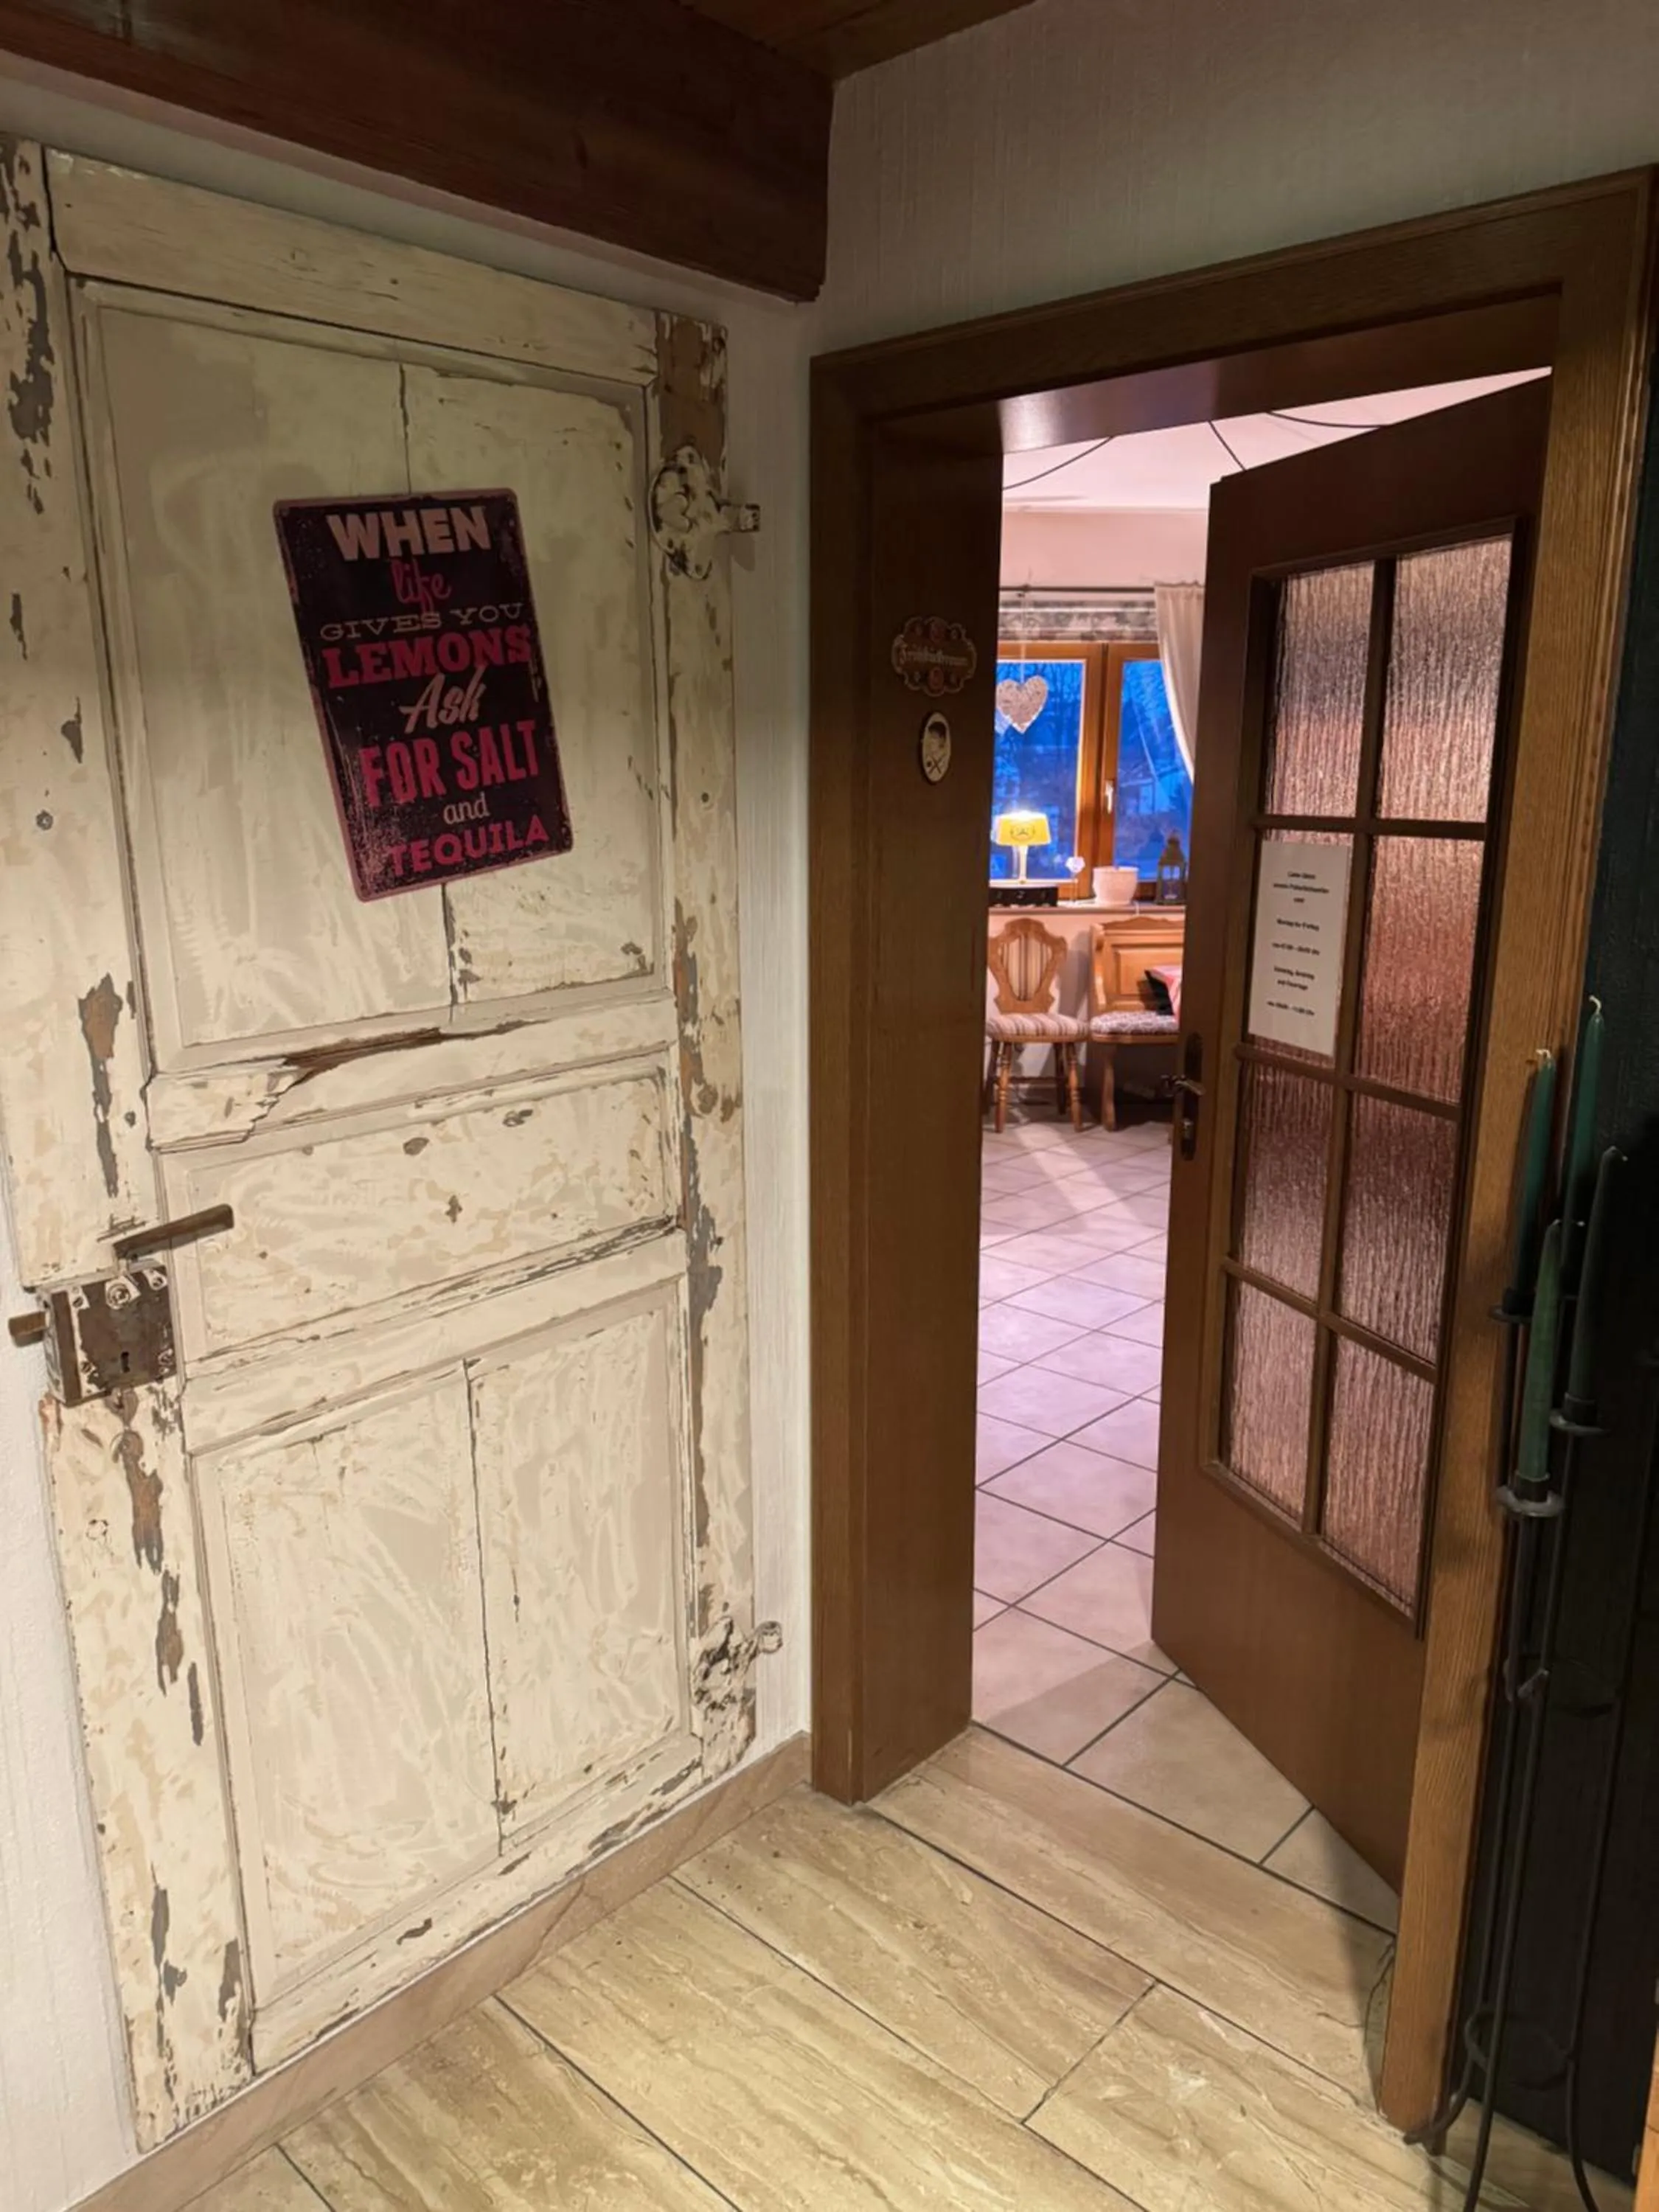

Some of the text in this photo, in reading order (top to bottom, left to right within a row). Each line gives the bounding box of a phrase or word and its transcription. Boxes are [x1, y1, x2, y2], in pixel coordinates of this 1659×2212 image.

[327, 507, 490, 560] WHEN
[391, 557, 452, 613] life
[320, 602, 523, 641] GIVES YOU
[322, 626, 532, 688] LEMONS
[399, 665, 488, 734] Ask
[360, 720, 540, 808] FOR SALT
[443, 791, 490, 826] and
[386, 814, 550, 877] TEQUILA
